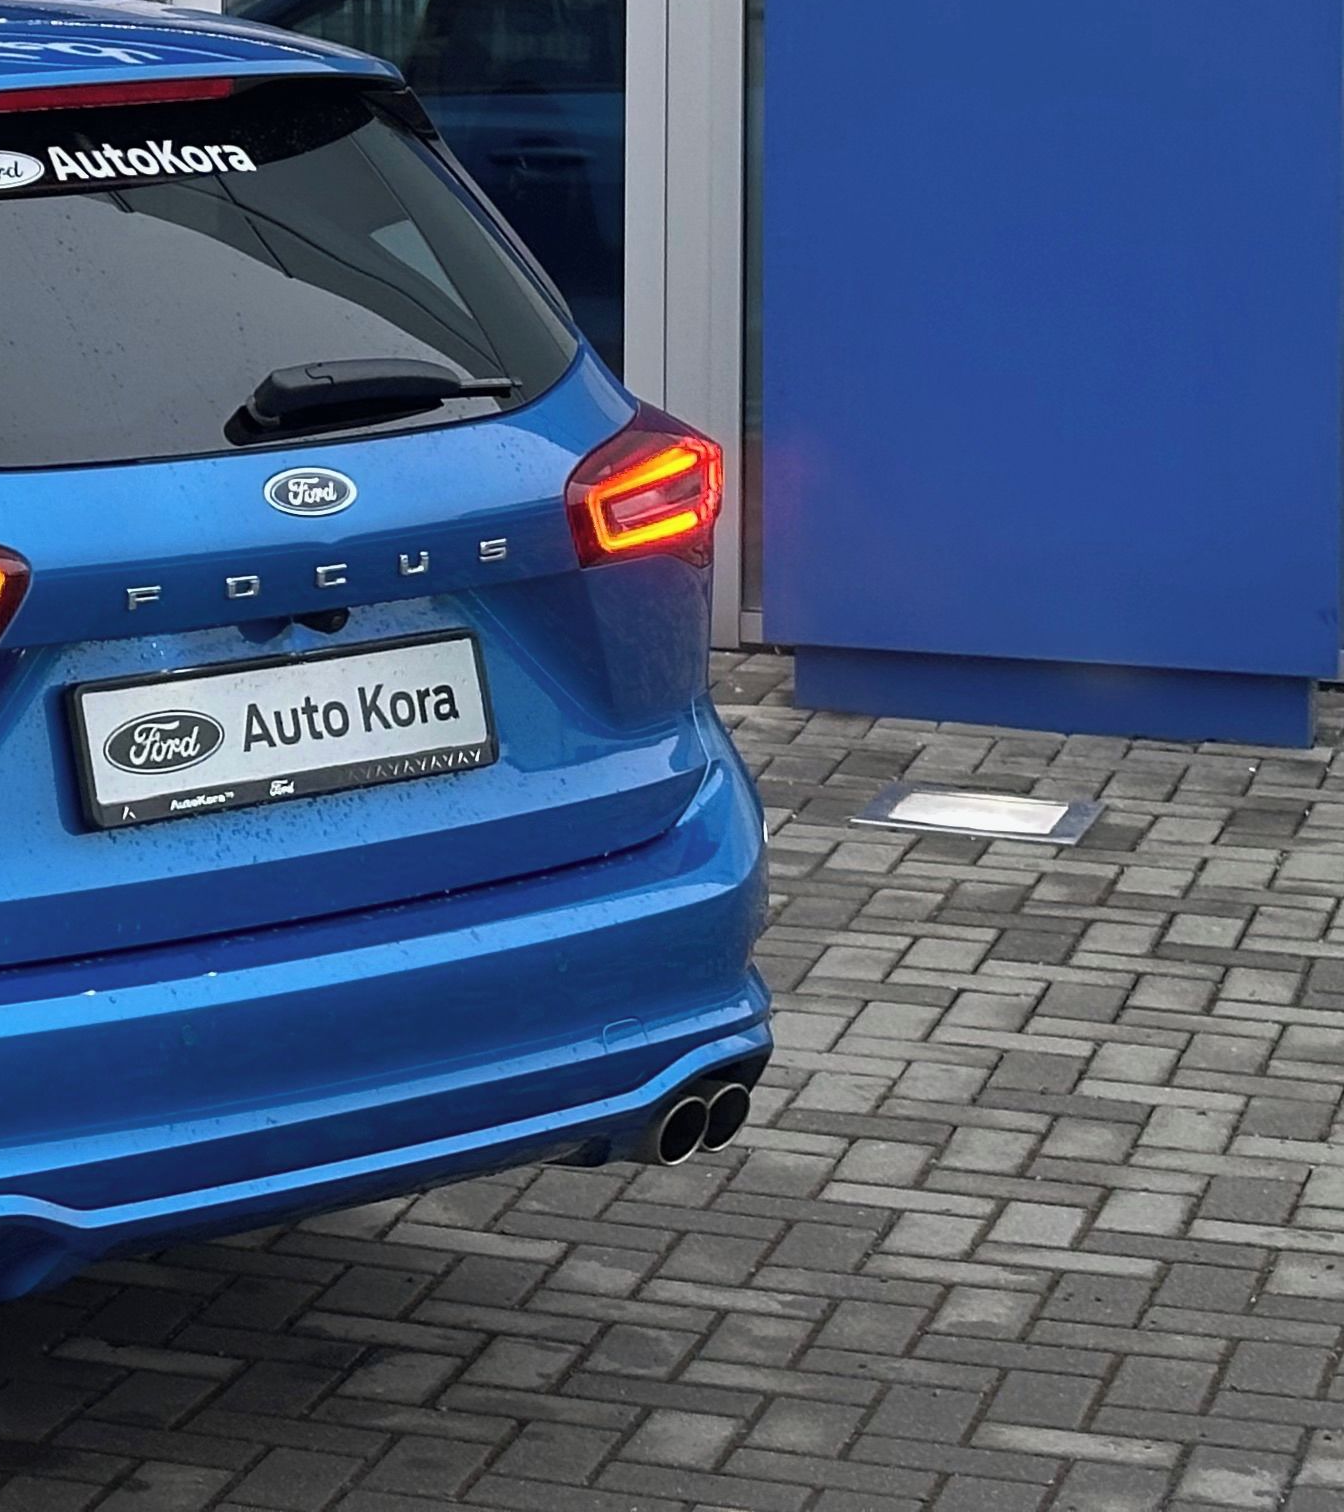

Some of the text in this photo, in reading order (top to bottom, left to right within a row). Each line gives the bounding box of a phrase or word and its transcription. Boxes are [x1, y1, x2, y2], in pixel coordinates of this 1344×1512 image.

[47, 140, 257, 181] AutoKora
[287, 477, 338, 506] Ford
[126, 538, 508, 611] FOCUS
[128, 683, 461, 766] Ford Auto Kora
